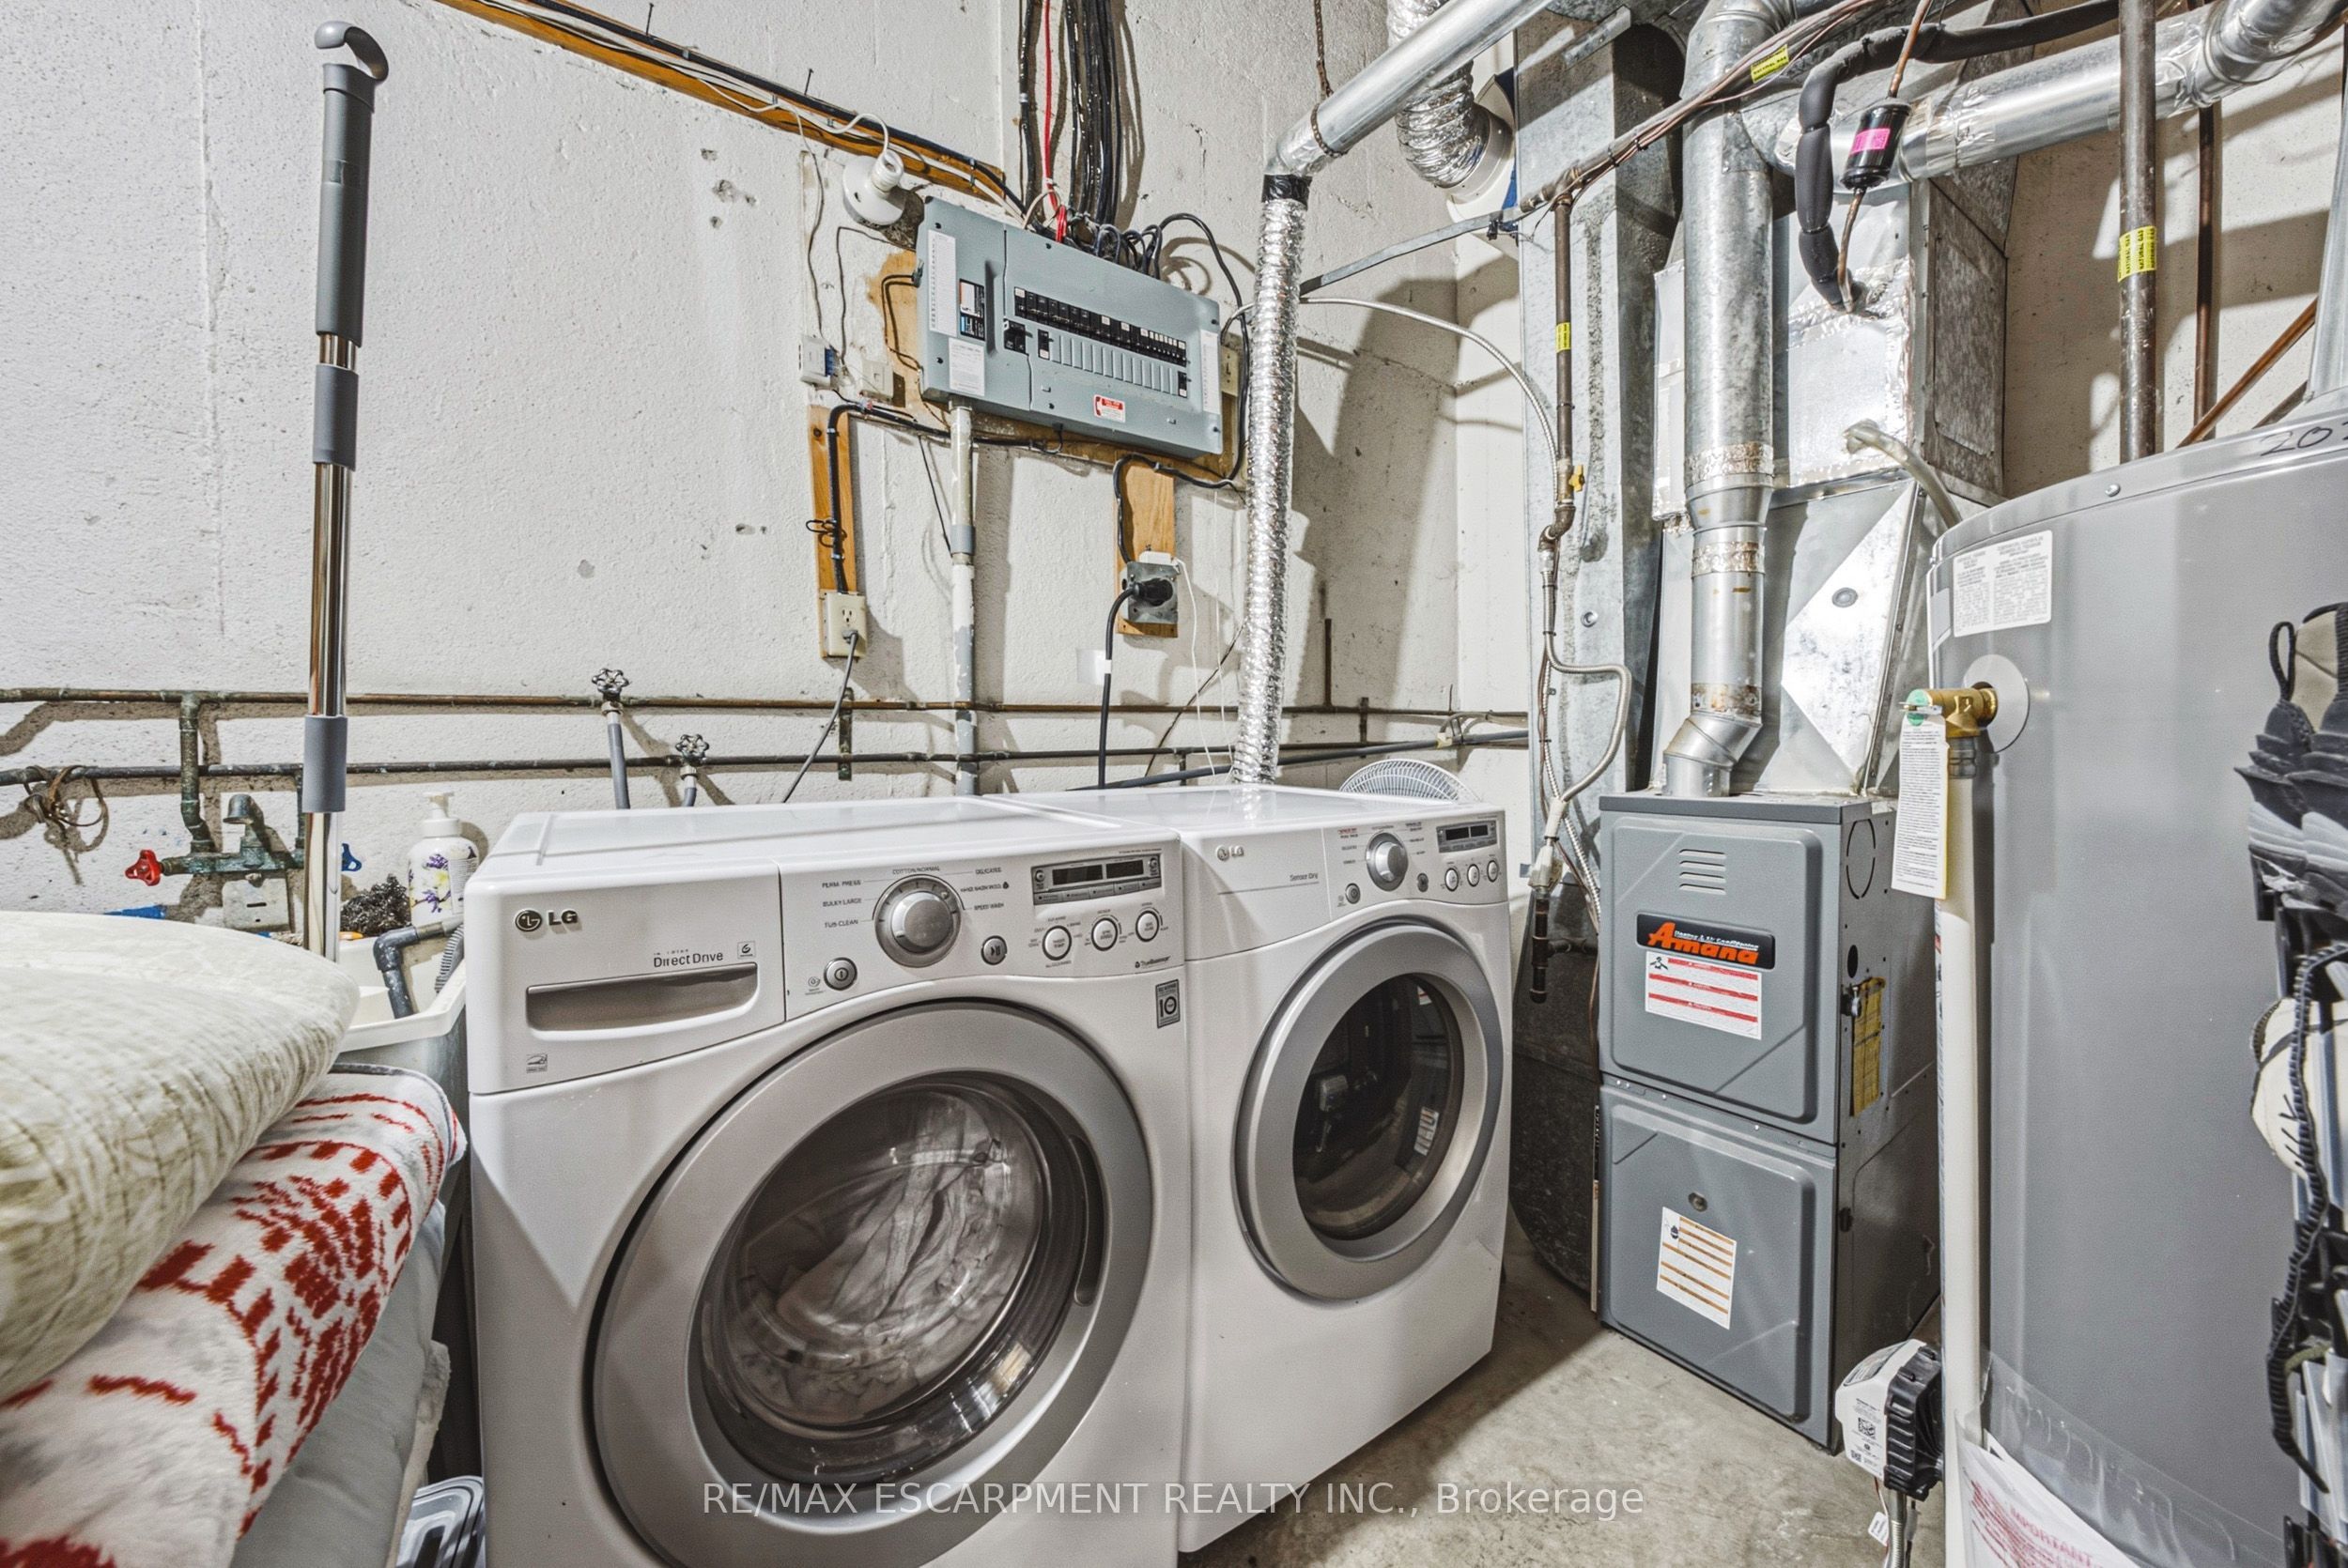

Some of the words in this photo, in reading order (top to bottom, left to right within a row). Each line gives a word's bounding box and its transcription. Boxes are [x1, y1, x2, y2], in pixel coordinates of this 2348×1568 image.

[2260, 422, 2348, 457] 20
[1229, 846, 1244, 857] LG
[548, 909, 579, 926] LG
[1646, 922, 1759, 965] Amana
[654, 954, 690, 968] Direct
[692, 951, 724, 964] Drive
